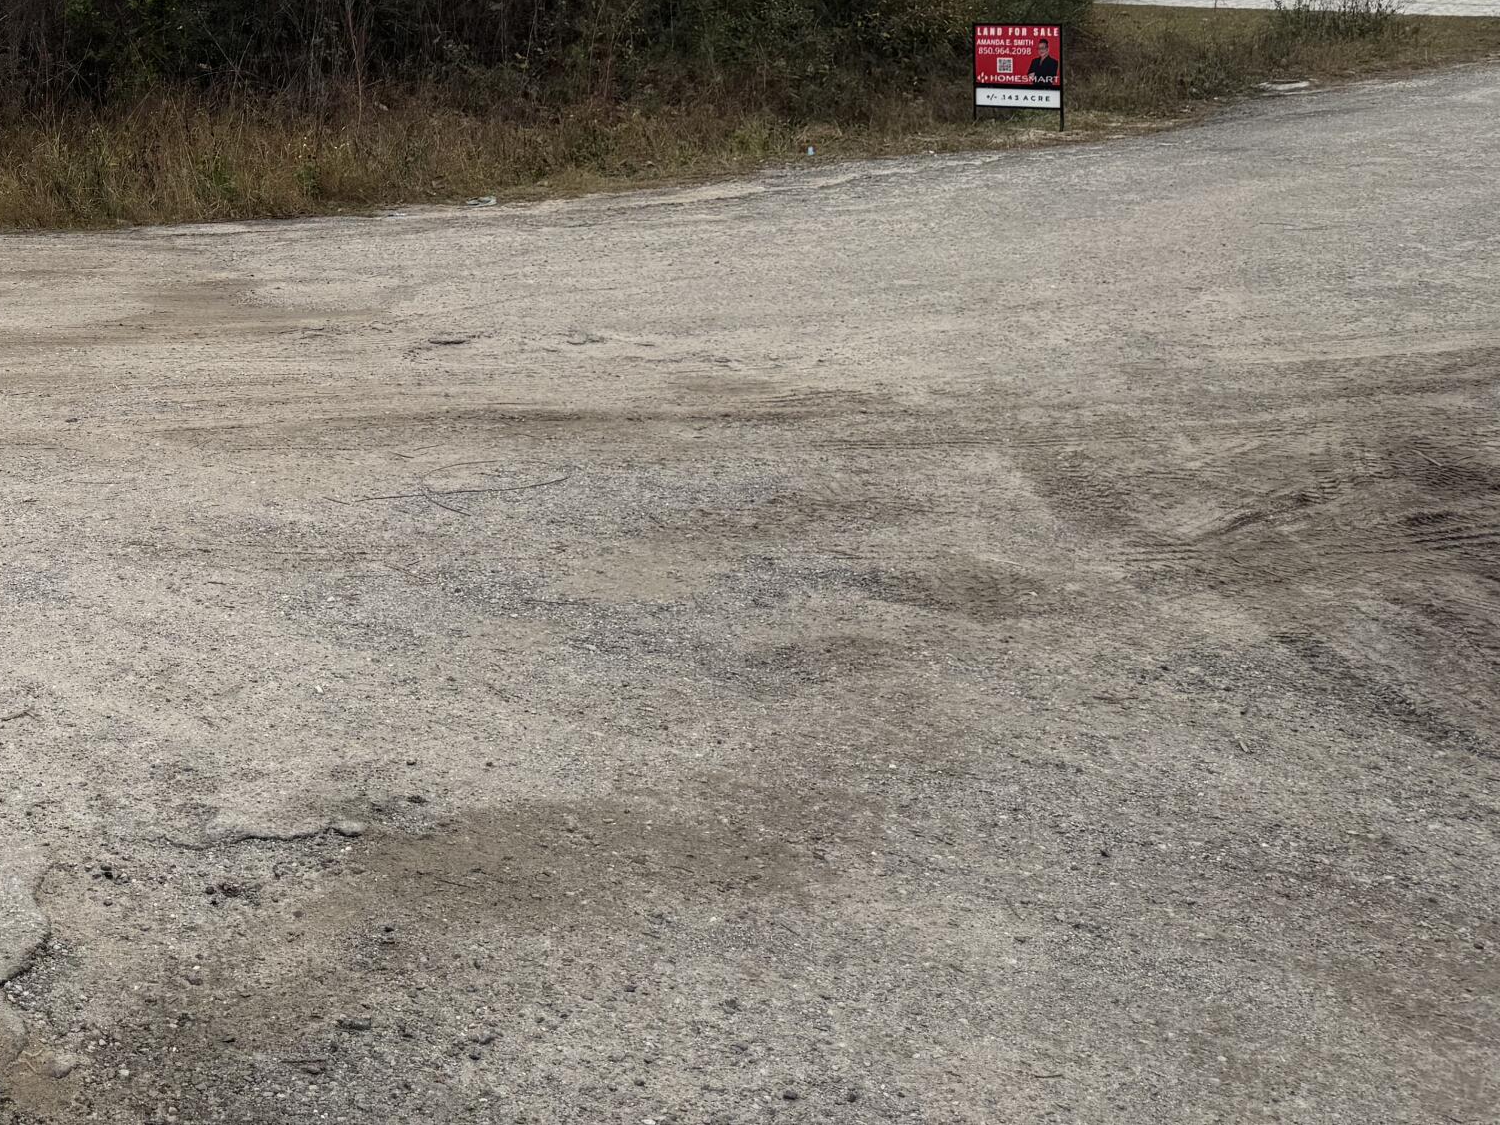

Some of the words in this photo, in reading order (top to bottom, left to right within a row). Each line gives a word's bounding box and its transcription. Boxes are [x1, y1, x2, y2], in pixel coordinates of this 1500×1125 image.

[977, 27, 1002, 36] LAND
[1008, 27, 1027, 36] FOR
[1033, 27, 1059, 36] SALE
